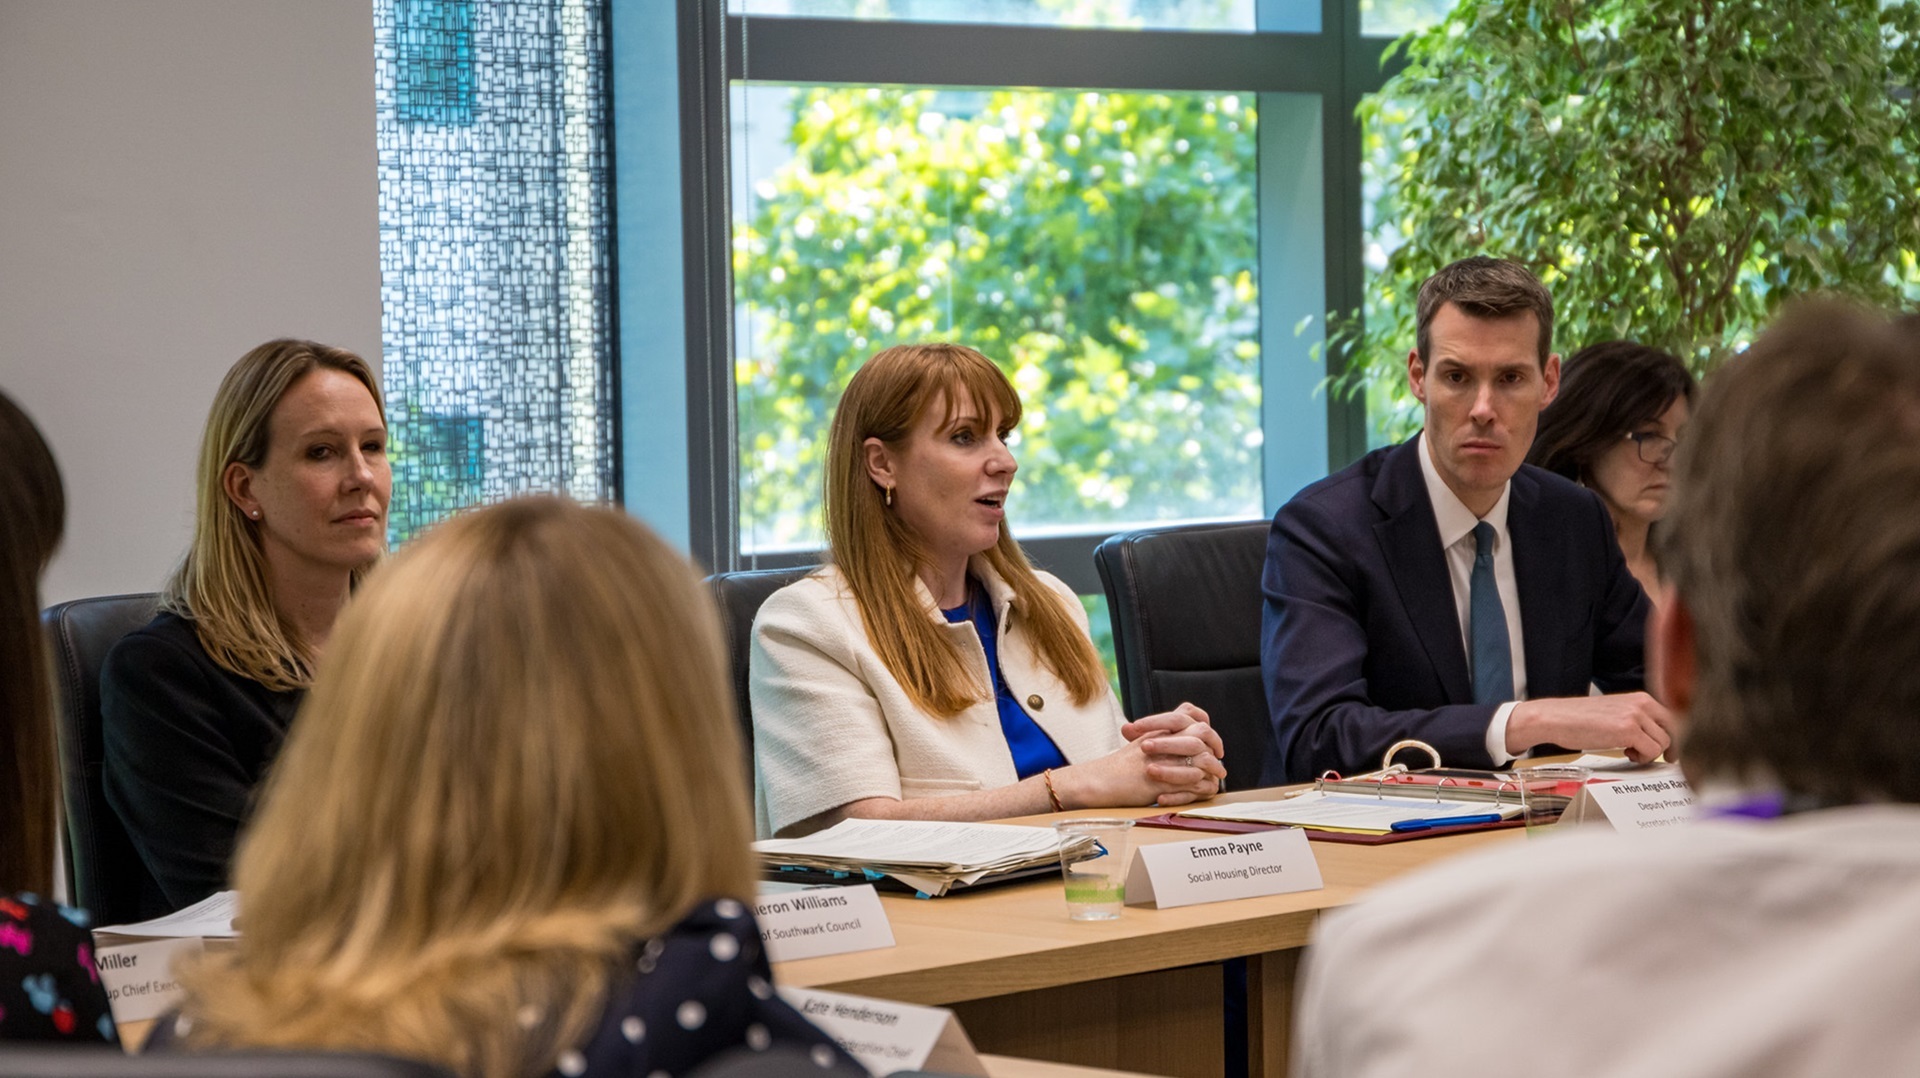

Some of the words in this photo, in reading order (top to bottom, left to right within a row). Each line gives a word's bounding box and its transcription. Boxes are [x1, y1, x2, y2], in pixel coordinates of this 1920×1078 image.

[1611, 785, 1624, 794] Rt
[1623, 783, 1641, 794] Hon
[1641, 780, 1670, 792] Angela
[1670, 779, 1689, 790] Ray
[1638, 800, 1665, 811] Deputy
[1663, 798, 1685, 808] Prime
[1190, 845, 1227, 859] Emma
[1228, 840, 1263, 856] Payne
[1187, 870, 1213, 884] Social
[1213, 867, 1249, 881] Housing
[1249, 862, 1283, 877] Director
[791, 895, 848, 911] Williams
[772, 923, 824, 940] Southwark
[825, 918, 862, 934] Council
[95, 953, 137, 972] Miller
[122, 981, 150, 998] Chief
